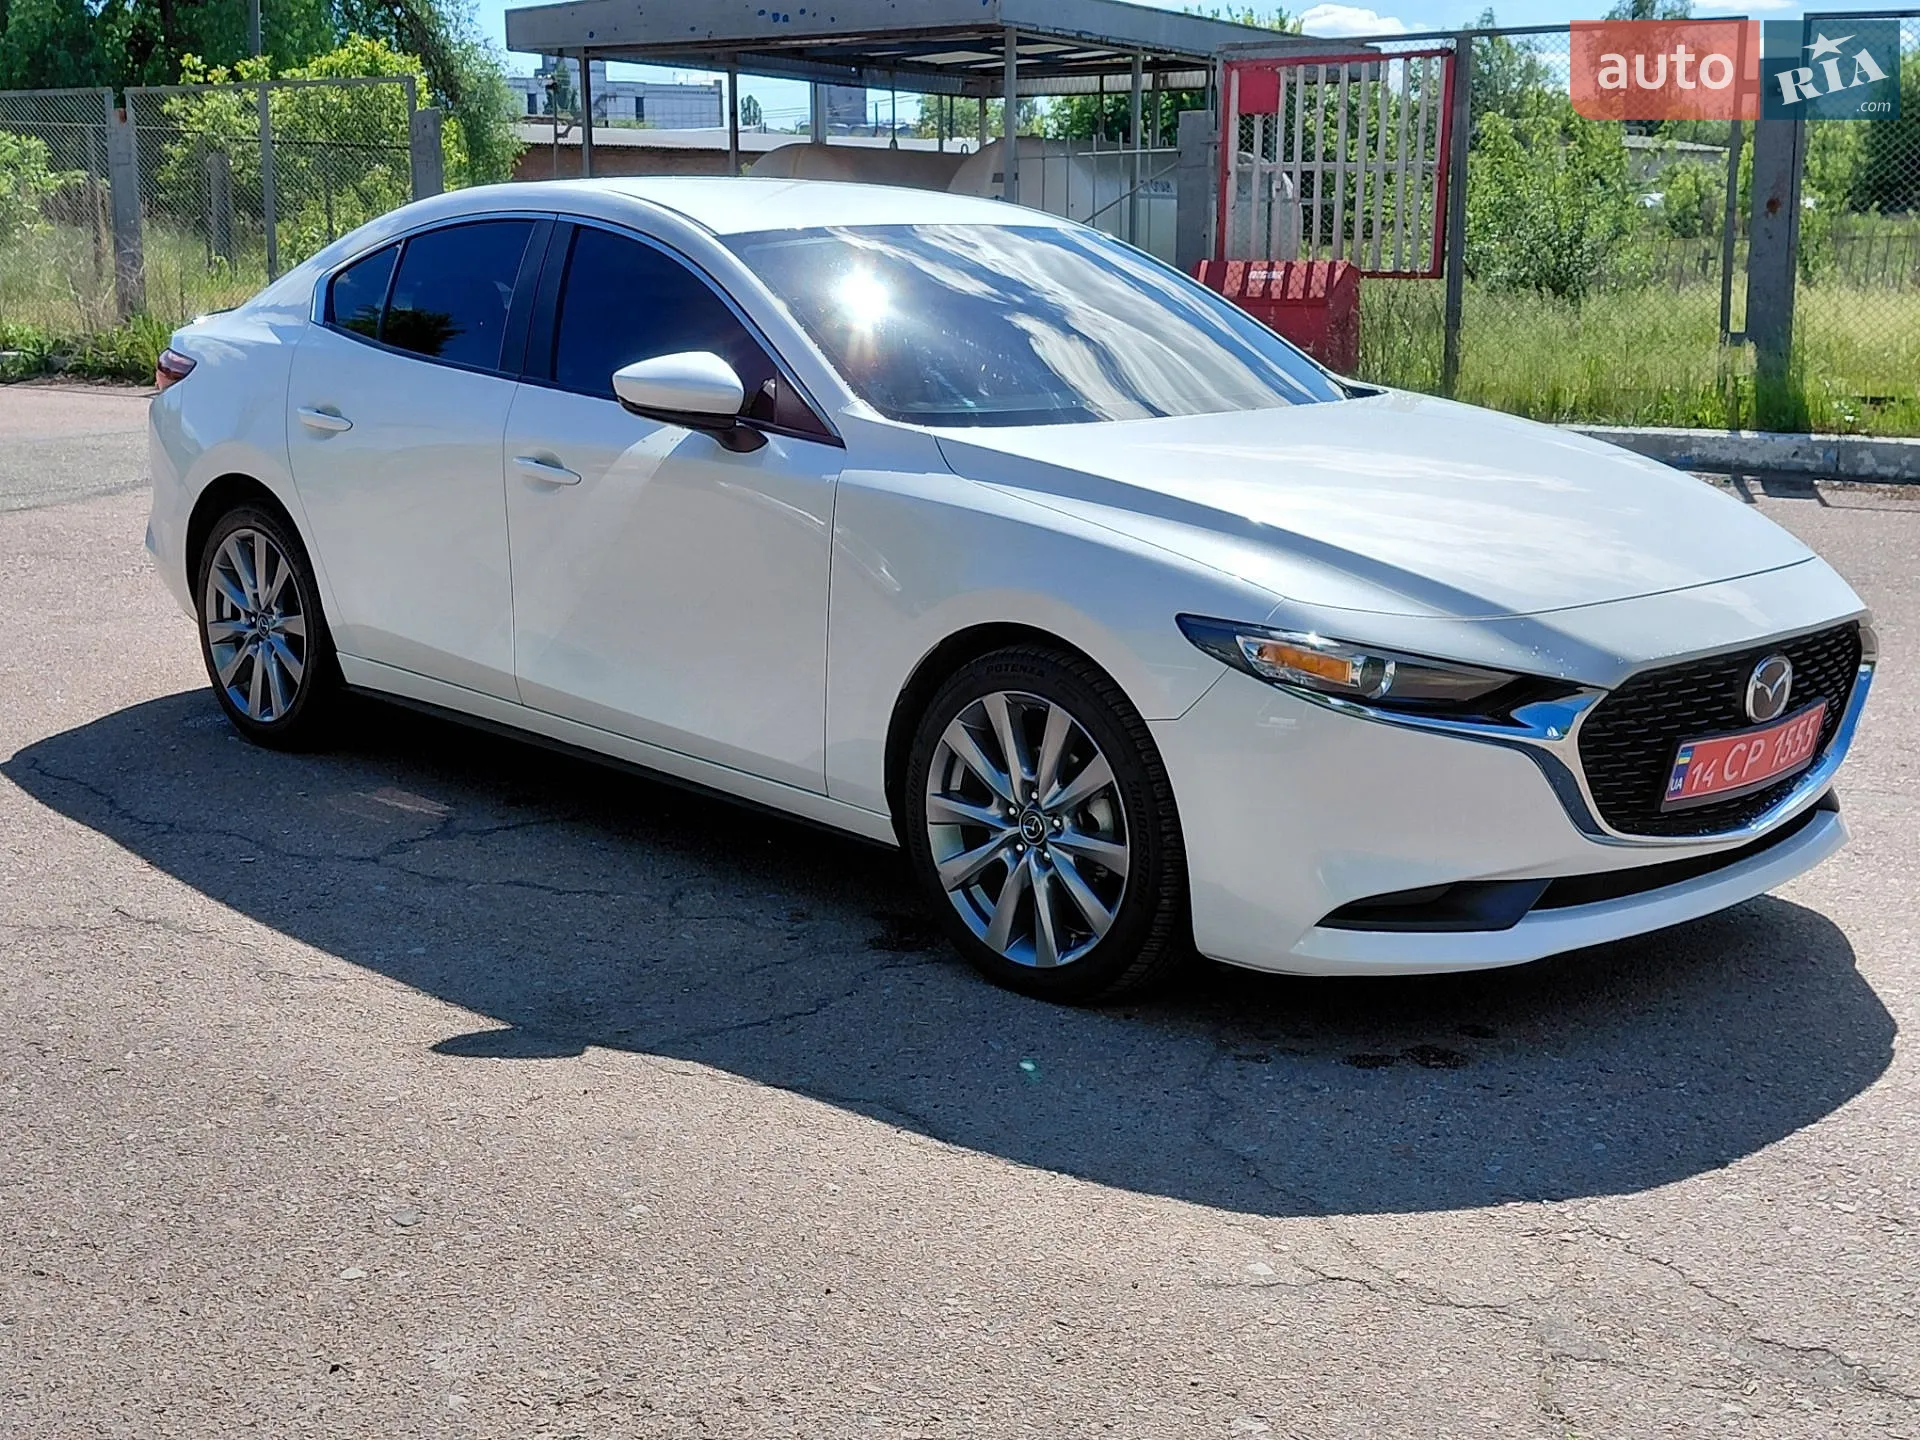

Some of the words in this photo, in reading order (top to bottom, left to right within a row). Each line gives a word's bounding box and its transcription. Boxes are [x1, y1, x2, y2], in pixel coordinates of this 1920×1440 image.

[987, 663, 1046, 678] POTENZA
[1692, 758, 1718, 791] 14
[1723, 739, 1765, 782] CP
[1772, 715, 1818, 769] 1555
[1670, 777, 1683, 791] UA
